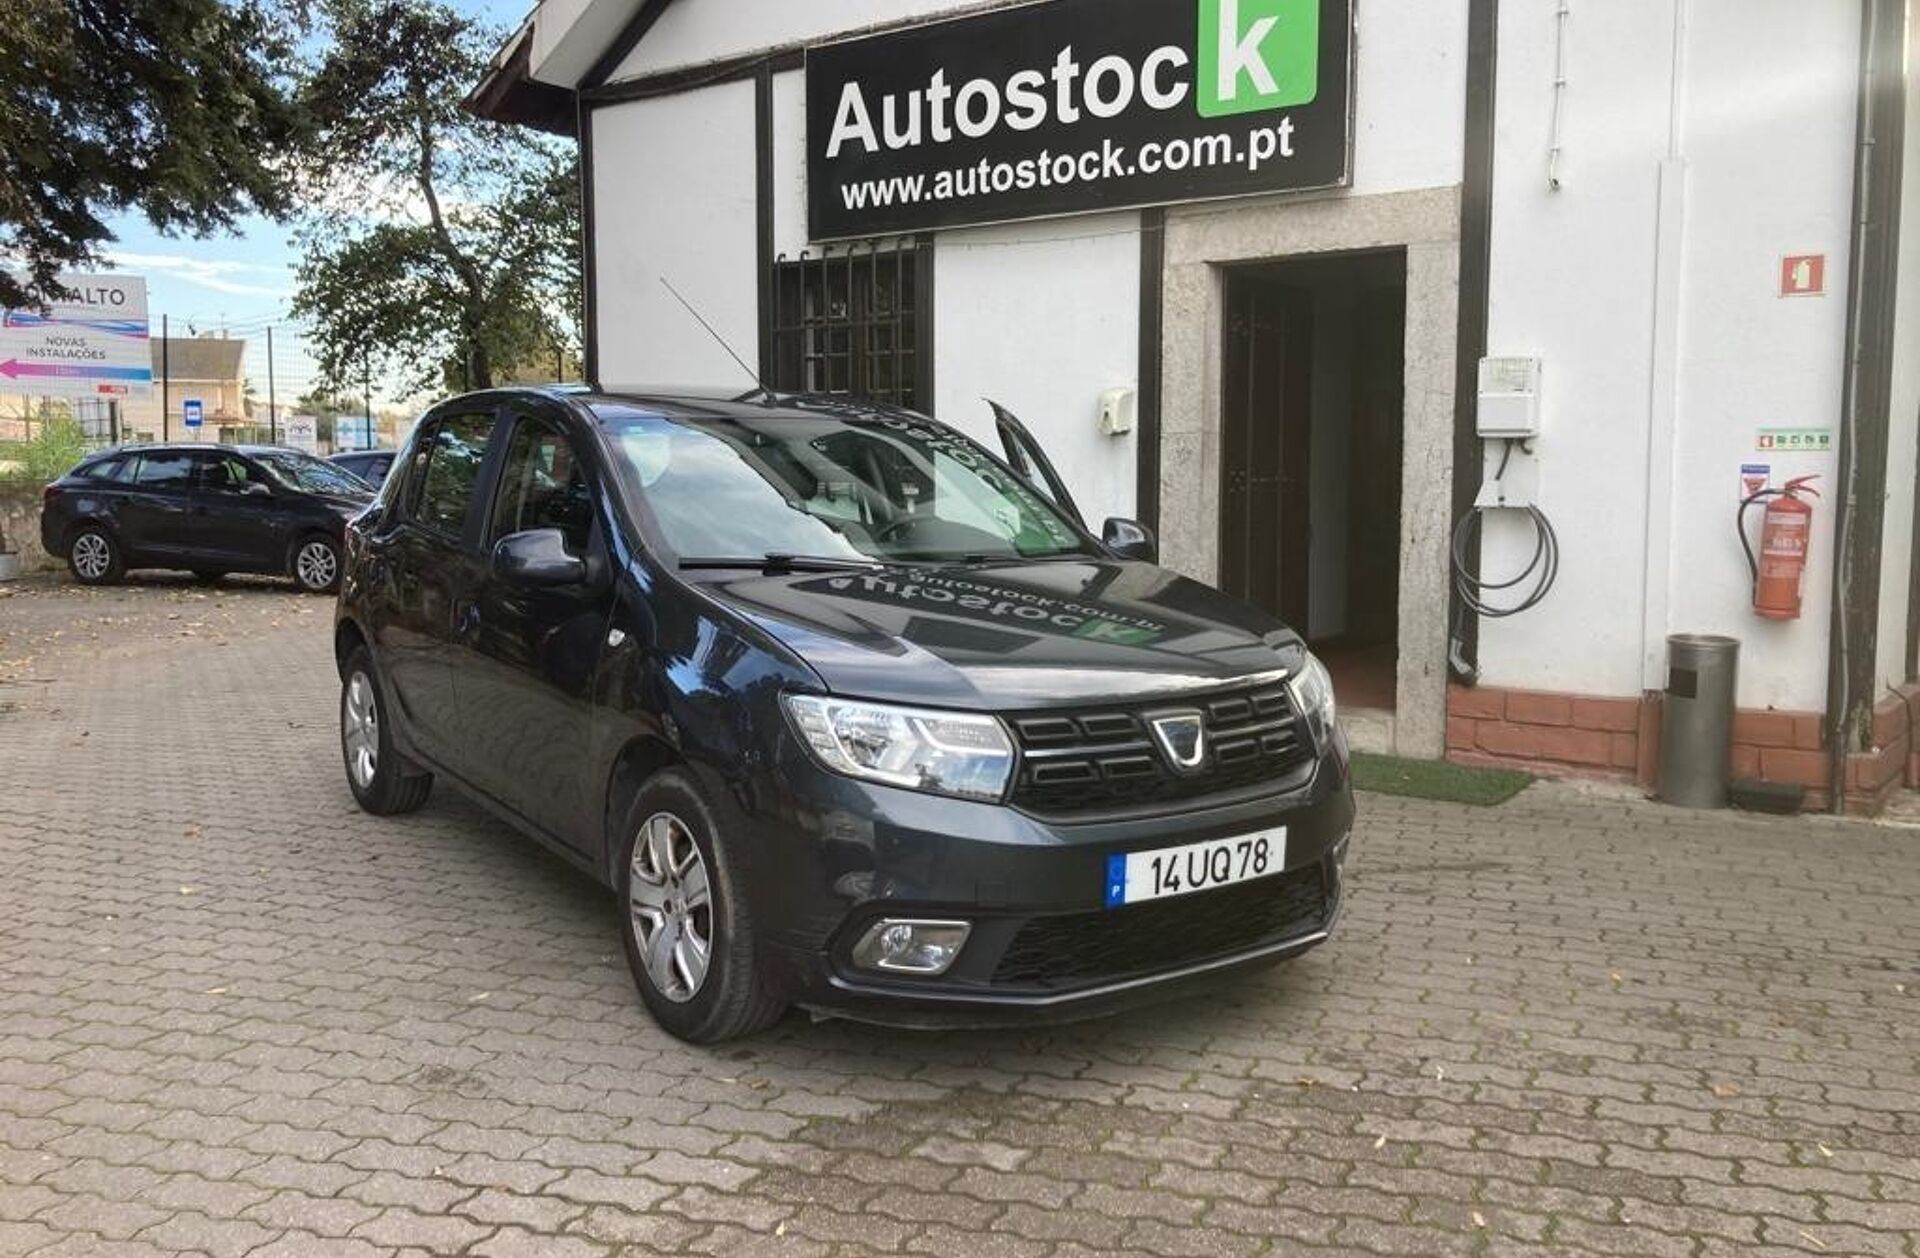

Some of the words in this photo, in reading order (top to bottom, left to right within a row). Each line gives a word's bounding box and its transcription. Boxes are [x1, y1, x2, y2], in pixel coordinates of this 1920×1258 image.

[826, 0, 1280, 157] Autostock
[841, 117, 1294, 209] www.autostock.com.pt
[46, 336, 87, 347] NOVAS
[26, 346, 106, 360] INSTALAÇÕES
[1111, 885, 1121, 897] P
